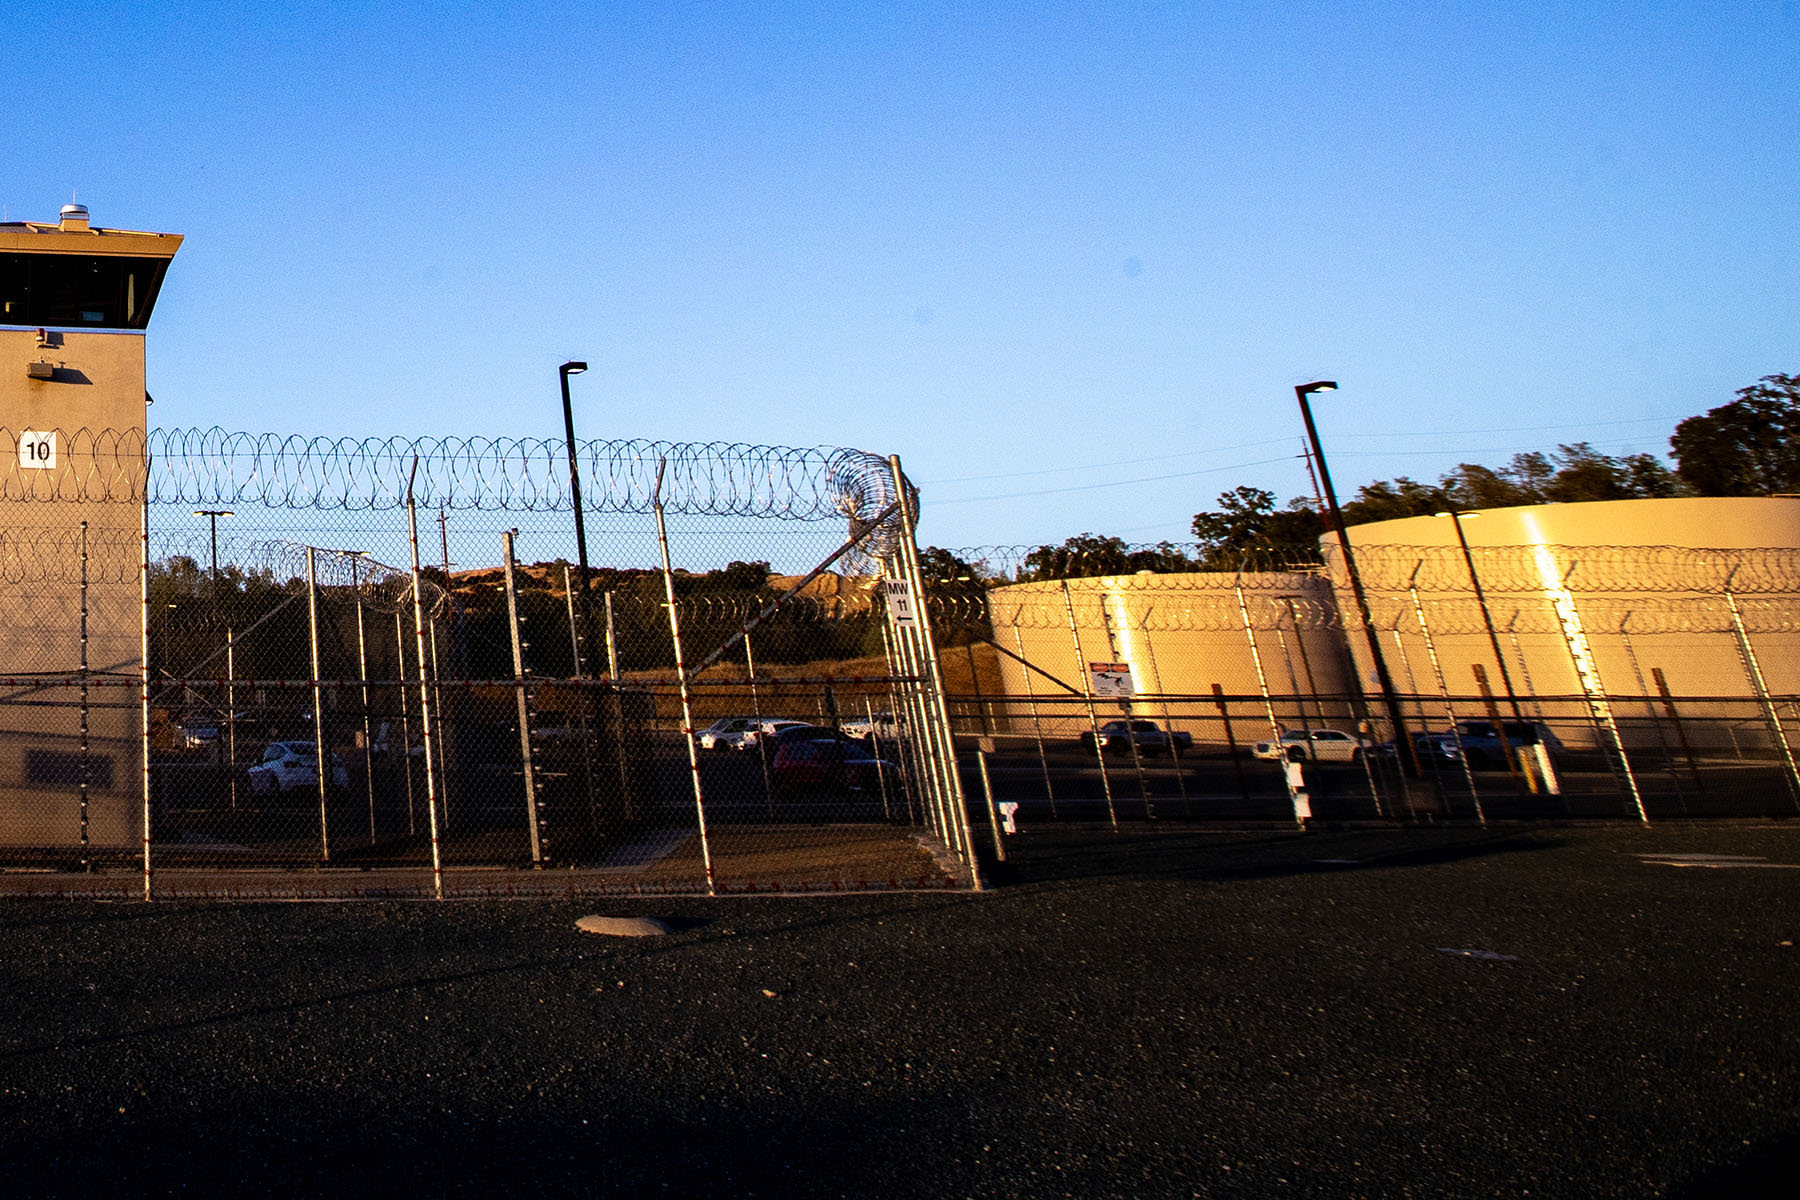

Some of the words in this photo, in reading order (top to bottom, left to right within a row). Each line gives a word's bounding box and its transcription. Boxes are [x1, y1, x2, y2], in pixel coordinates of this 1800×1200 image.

[26, 441, 50, 461] 10
[887, 582, 909, 595] MW
[896, 599, 908, 611] 11
